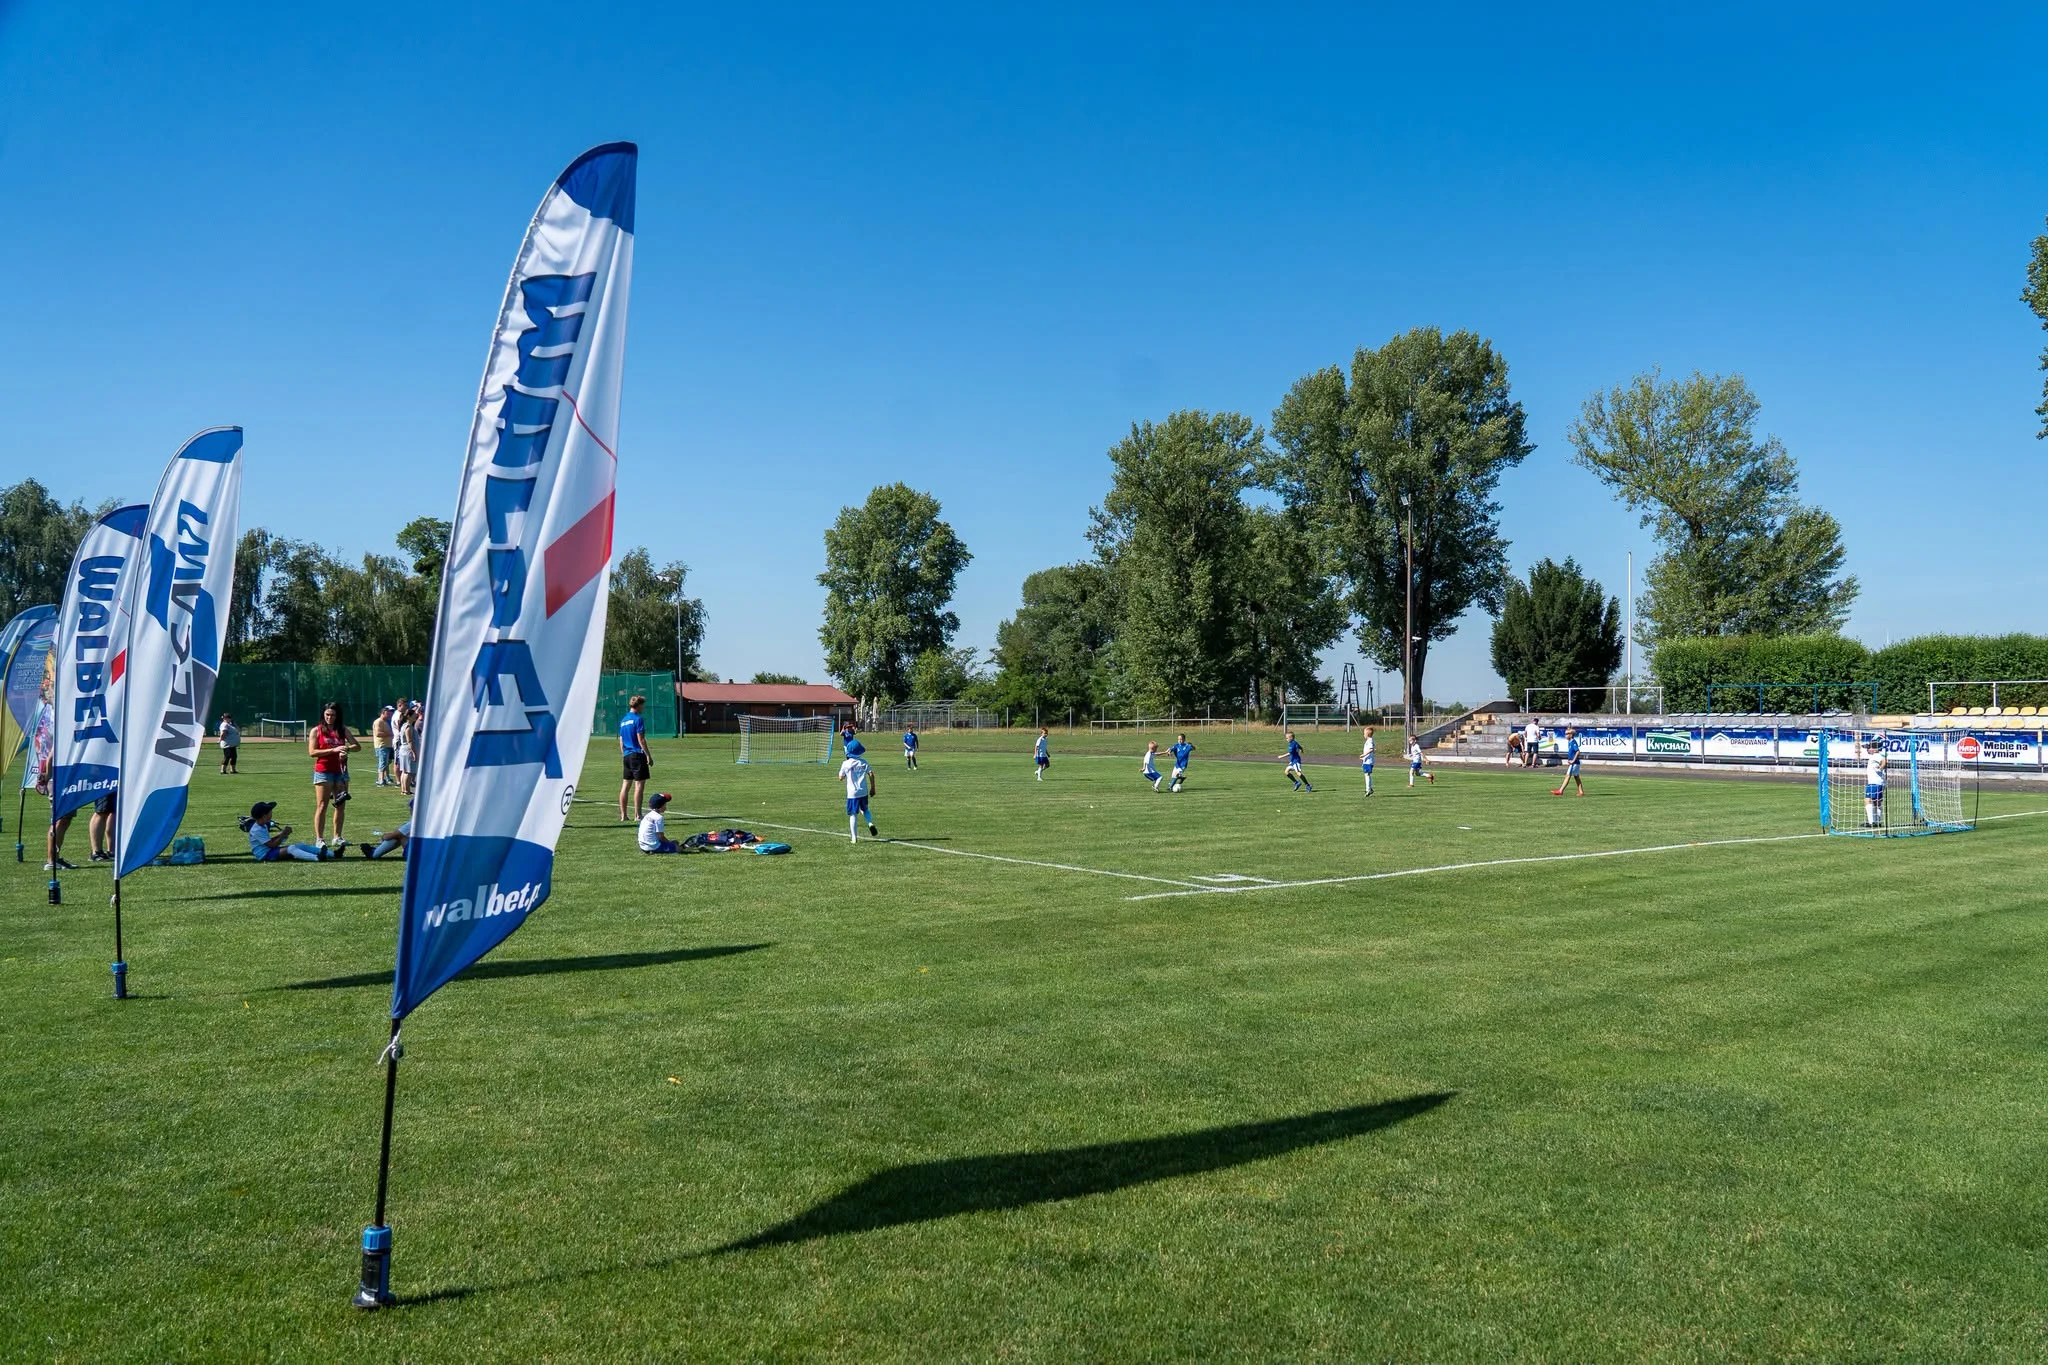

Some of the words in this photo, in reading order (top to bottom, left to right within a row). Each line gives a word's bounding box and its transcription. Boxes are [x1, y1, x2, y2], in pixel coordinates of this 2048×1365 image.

[74, 555, 126, 744] WALBET
[1578, 733, 1627, 747] Jamalex
[1984, 741, 2015, 751] Meble
[2016, 743, 2029, 751] na
[1983, 750, 2021, 759] wymiar
